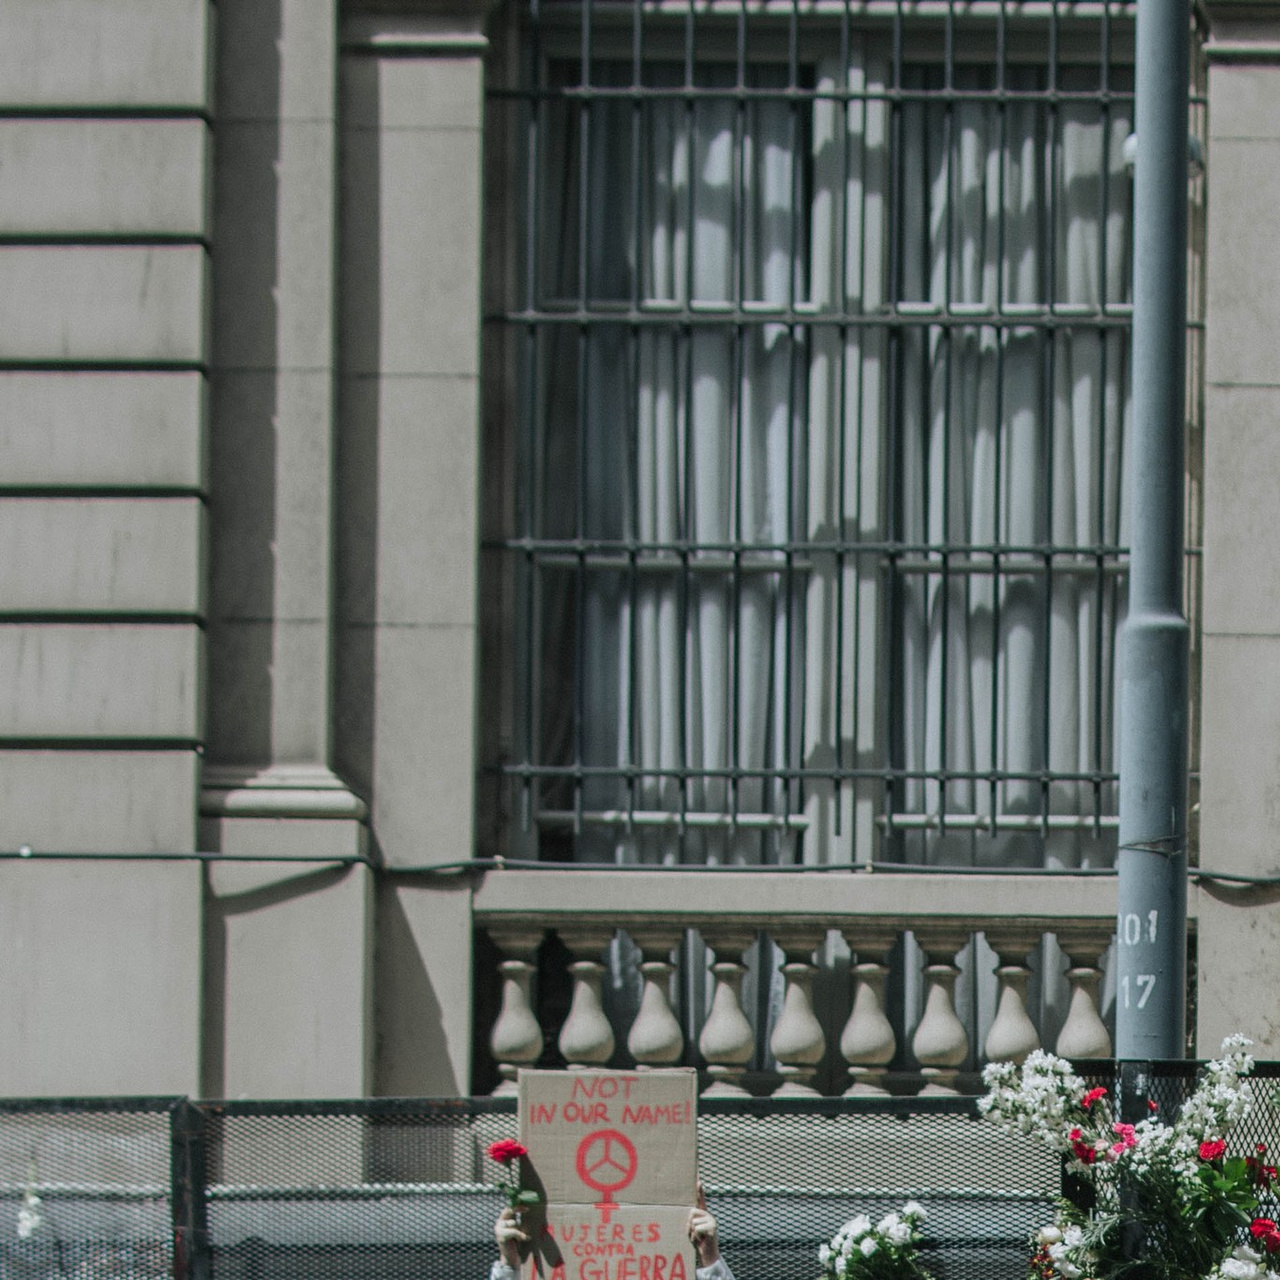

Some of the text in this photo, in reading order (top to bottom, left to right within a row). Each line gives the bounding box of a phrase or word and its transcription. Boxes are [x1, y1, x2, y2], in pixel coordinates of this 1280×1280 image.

[1122, 974, 1156, 1008] 17
[572, 1077, 638, 1099] NOT
[530, 1101, 691, 1125] IN OUR NAME!
[573, 1244, 634, 1256] CONTRA
